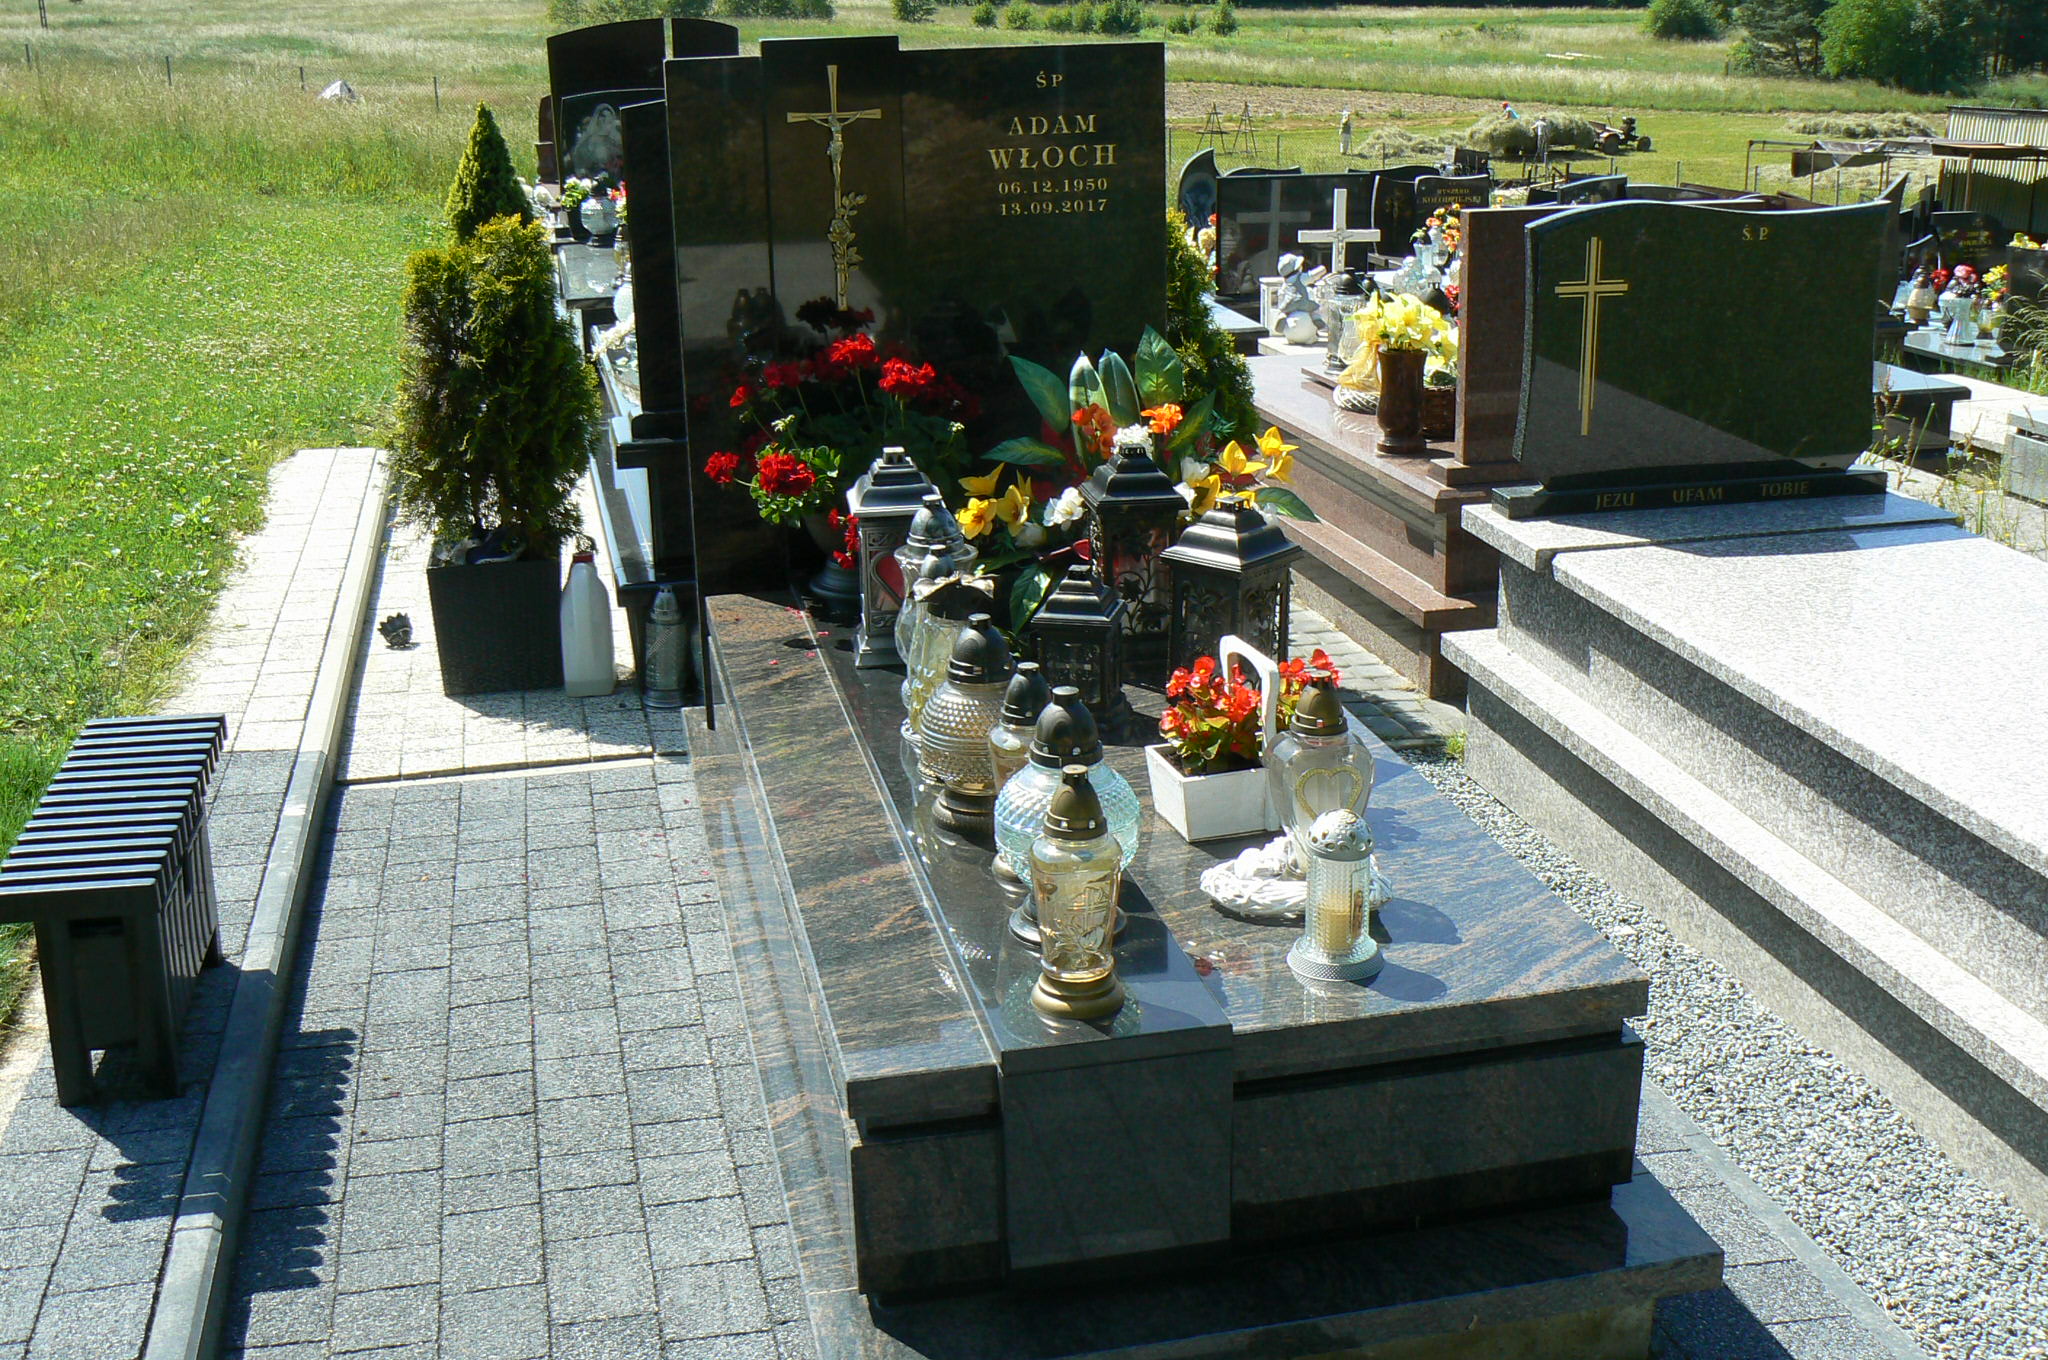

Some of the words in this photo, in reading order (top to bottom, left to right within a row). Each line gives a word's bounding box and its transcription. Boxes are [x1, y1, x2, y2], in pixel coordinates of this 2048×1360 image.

[1008, 114, 1097, 136] ADAM
[988, 144, 1118, 170] WŁOCH
[998, 177, 1108, 195] 06.12.1950
[1000, 199, 1108, 216] 13.09.2017
[1595, 492, 1636, 511] JEZU
[1672, 487, 1724, 503] UFAM
[1759, 480, 1809, 497] TOBIE
